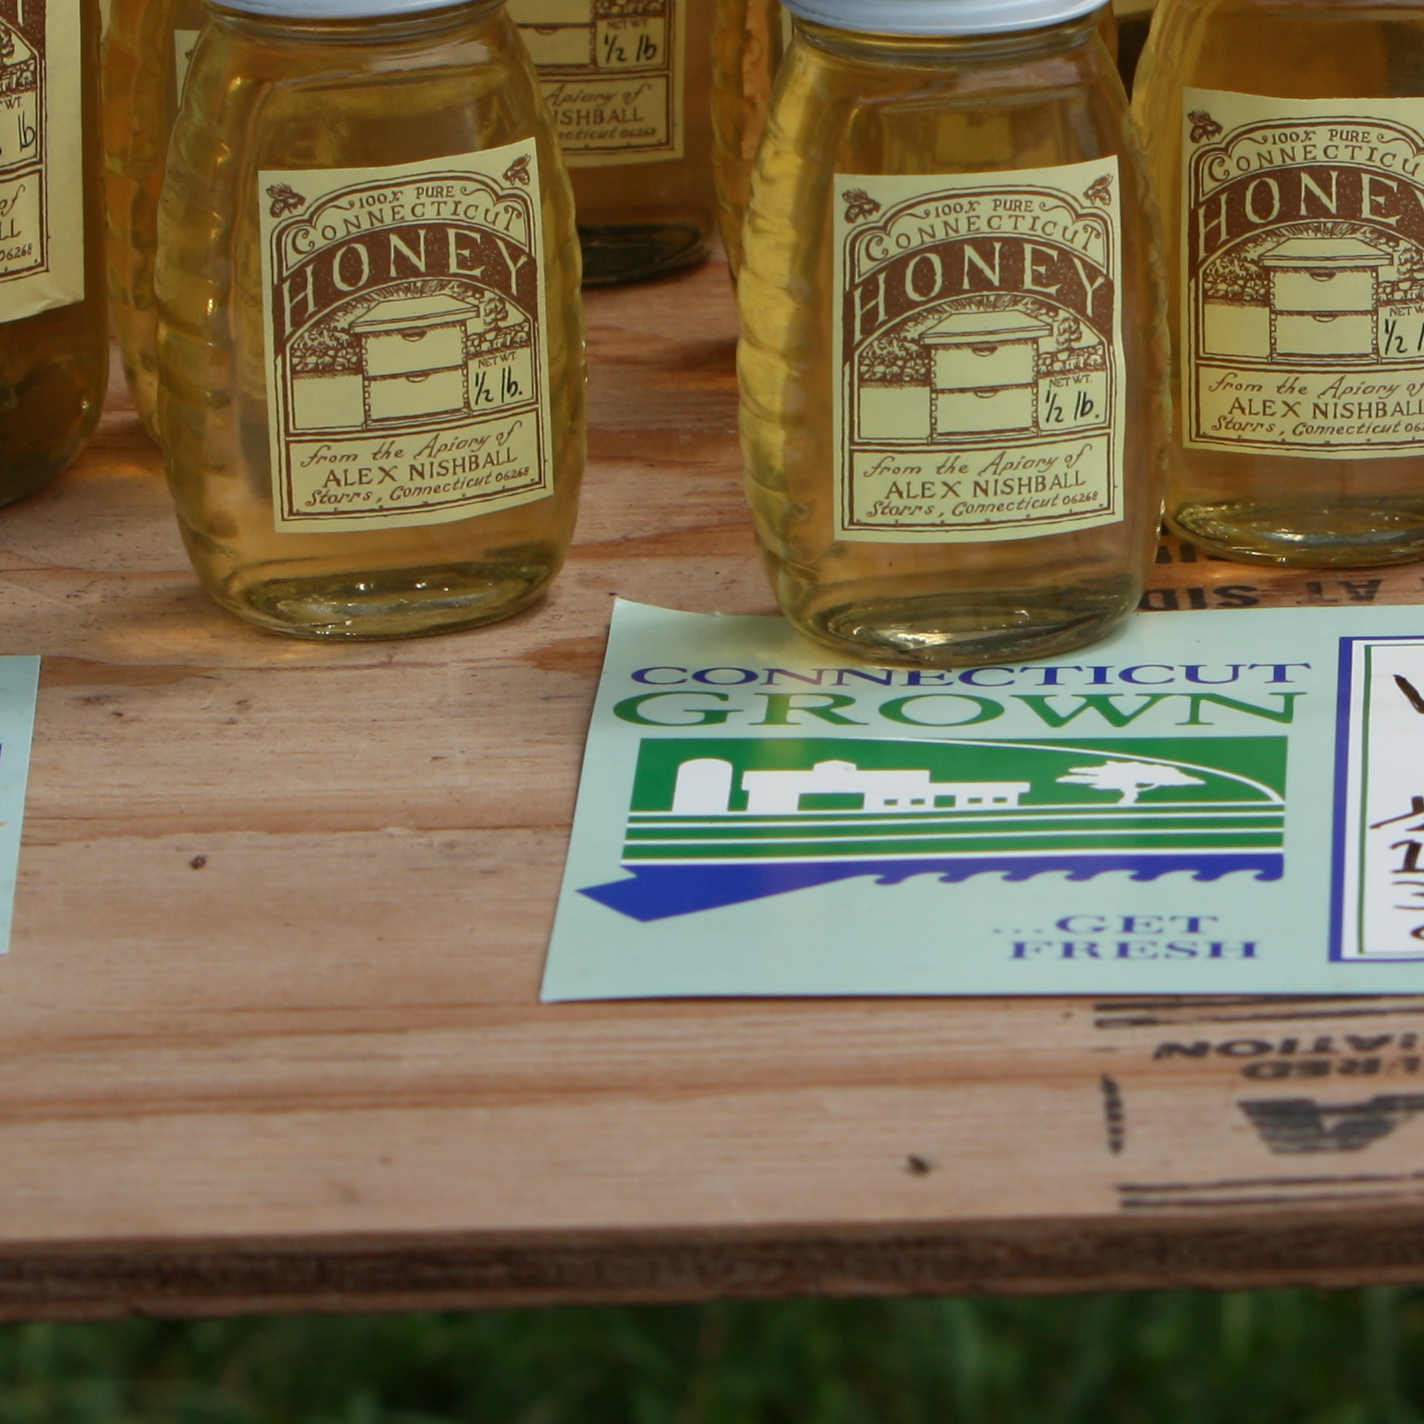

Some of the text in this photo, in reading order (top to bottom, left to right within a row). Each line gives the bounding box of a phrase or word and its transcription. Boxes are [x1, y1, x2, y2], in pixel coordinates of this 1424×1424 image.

[543, 83, 651, 105] Apiary of
[1328, 128, 1372, 143] PURE
[416, 186, 454, 199] PURE
[992, 198, 1033, 212] PURE
[292, 201, 522, 255] CONNECTICUT
[866, 215, 1102, 262] CONNECTICUT
[283, 228, 528, 337] HONEY
[854, 241, 1104, 347] HONEY
[1389, 306, 1412, 317] NET
[478, 357, 498, 368] NET
[1049, 377, 1071, 388] NET
[1208, 372, 1262, 392] from
[1276, 376, 1308, 395] the
[1317, 375, 1400, 399] Apiary
[1227, 397, 1302, 417] ALEX
[1292, 420, 1401, 436] Connecticut
[300, 420, 522, 467] from the Apiary of
[323, 447, 517, 488] ALEX NISHBALL
[864, 444, 1092, 476] from the Apiary of
[390, 475, 492, 500] Connecticut
[496, 466, 529, 483] 06268
[884, 471, 1086, 500] ALEX NISHBALL
[952, 496, 1059, 517] Connecticut
[1062, 491, 1098, 505] 06268
[1138, 585, 1257, 612] SID
[1298, 578, 1383, 604] AT
[630, 662, 1312, 688] CONNECTICUT
[612, 689, 1309, 730] GROWN
[1009, 940, 1261, 960] FRESH
